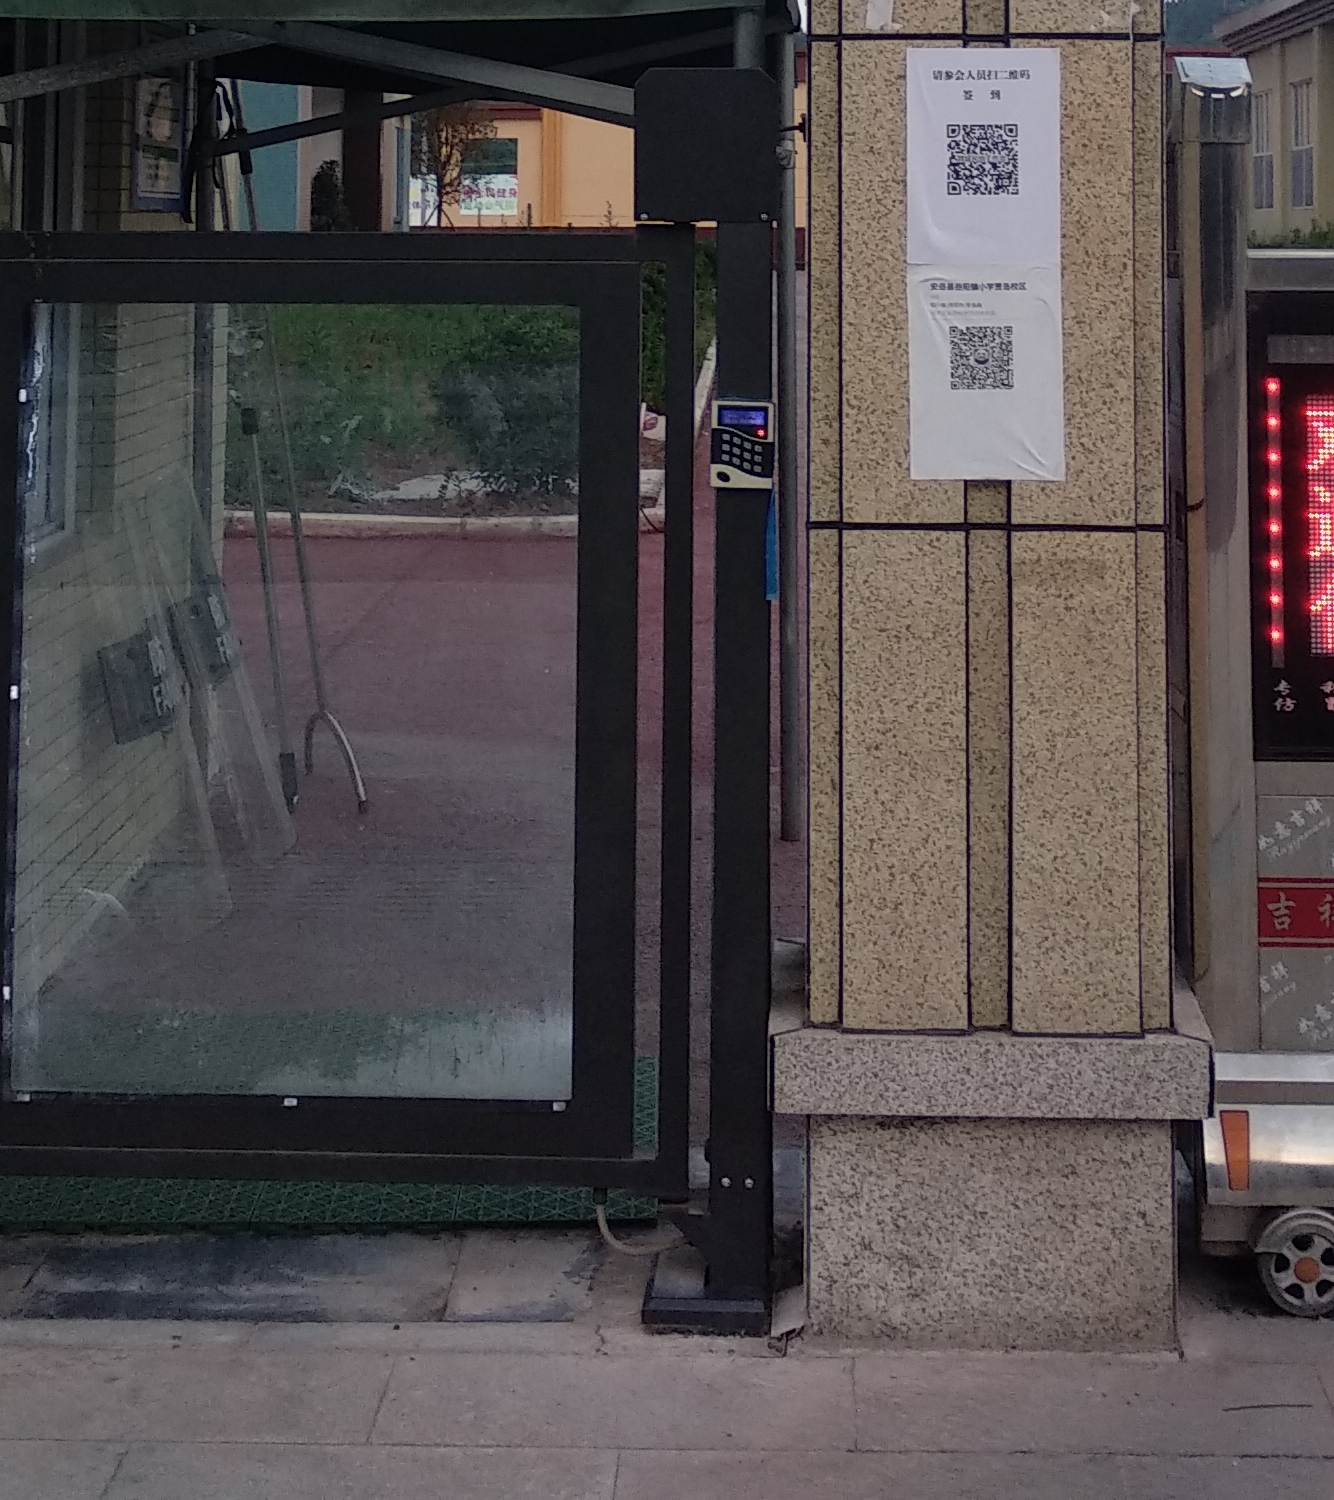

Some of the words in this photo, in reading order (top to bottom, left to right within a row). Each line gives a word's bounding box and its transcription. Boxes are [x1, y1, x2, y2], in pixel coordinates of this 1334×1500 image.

[932, 69, 1031, 81] 请参会人员扫二维码
